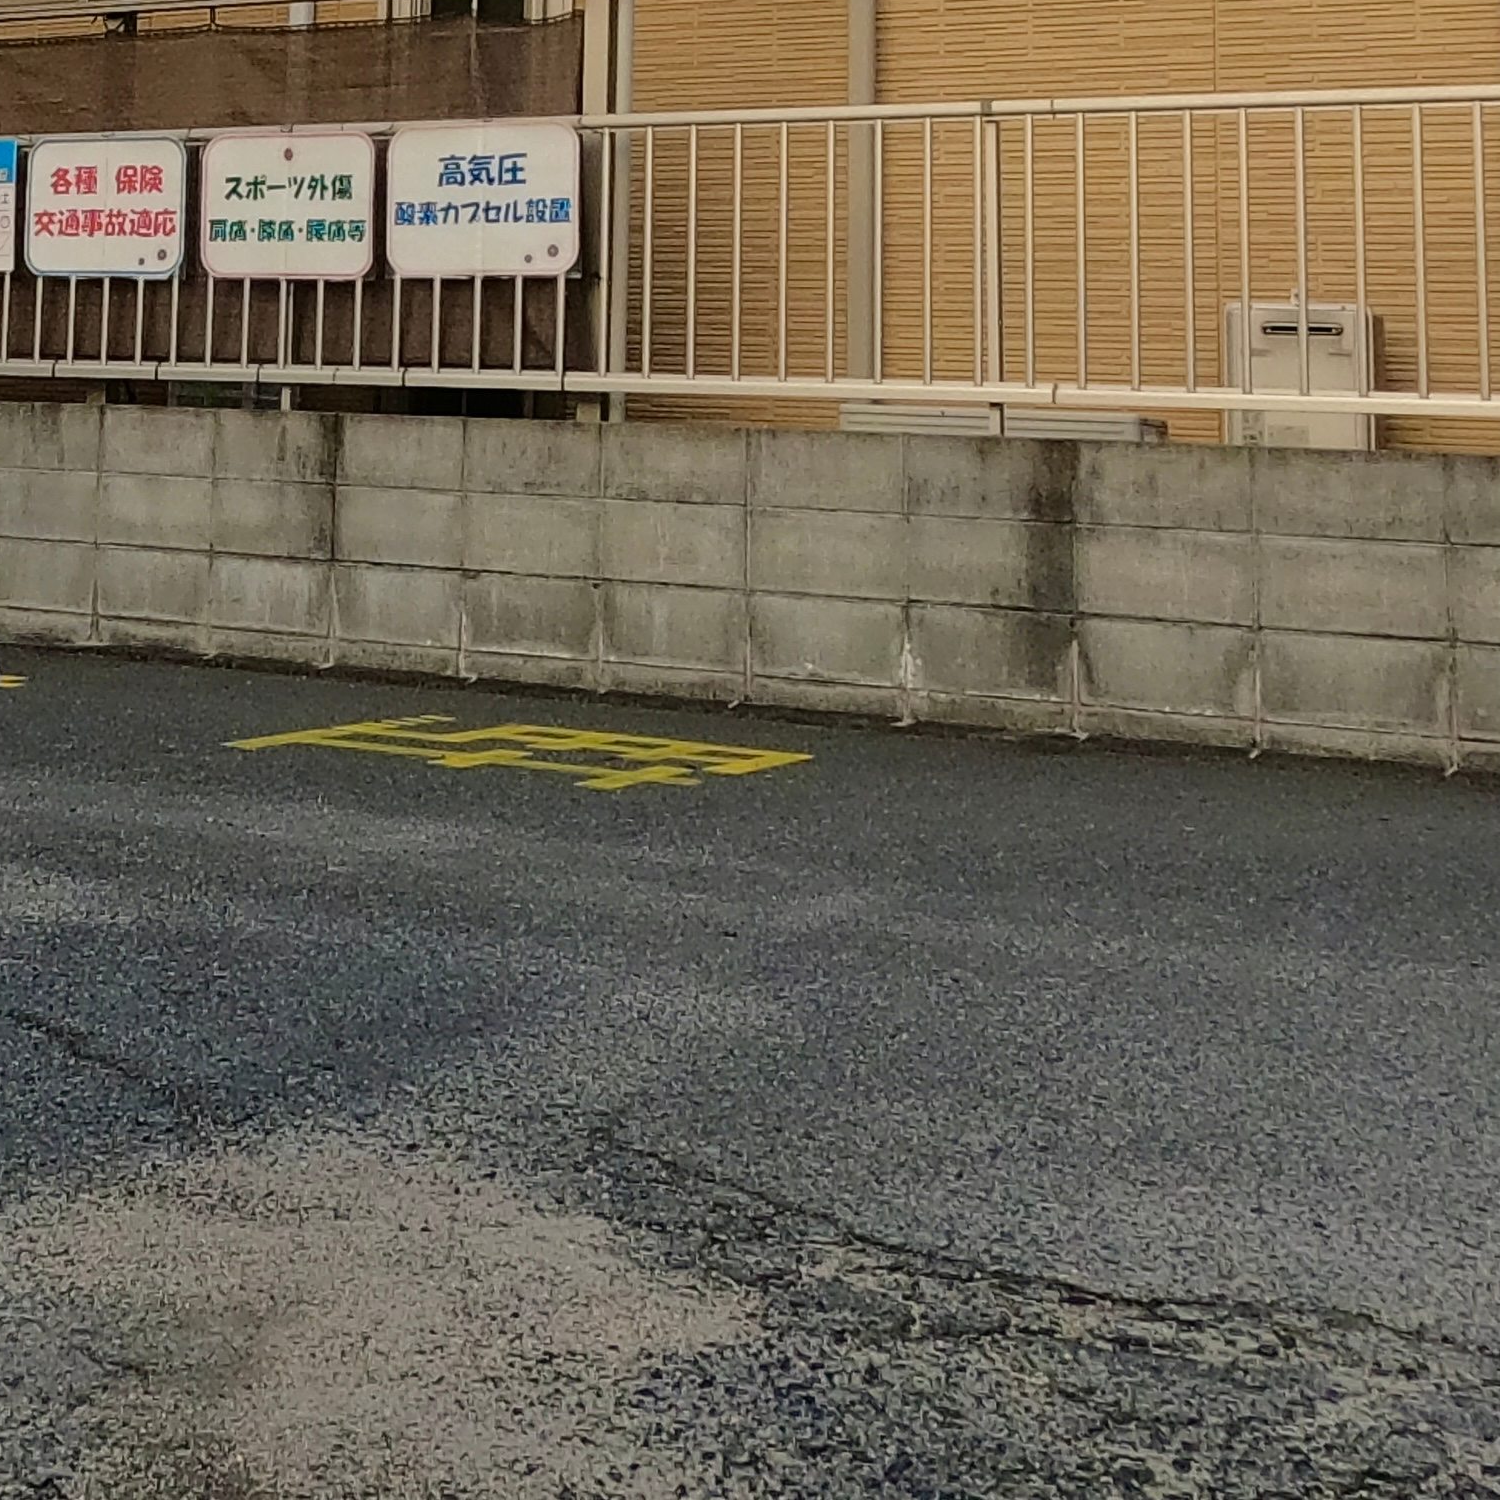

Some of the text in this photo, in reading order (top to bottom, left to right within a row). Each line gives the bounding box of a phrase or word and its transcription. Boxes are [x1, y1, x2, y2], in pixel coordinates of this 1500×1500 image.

[50, 165, 164, 194] 各種 保険
[437, 153, 527, 187] 高気圧
[225, 174, 353, 201] スポーツ外傷
[34, 208, 177, 237] 交通事故適応
